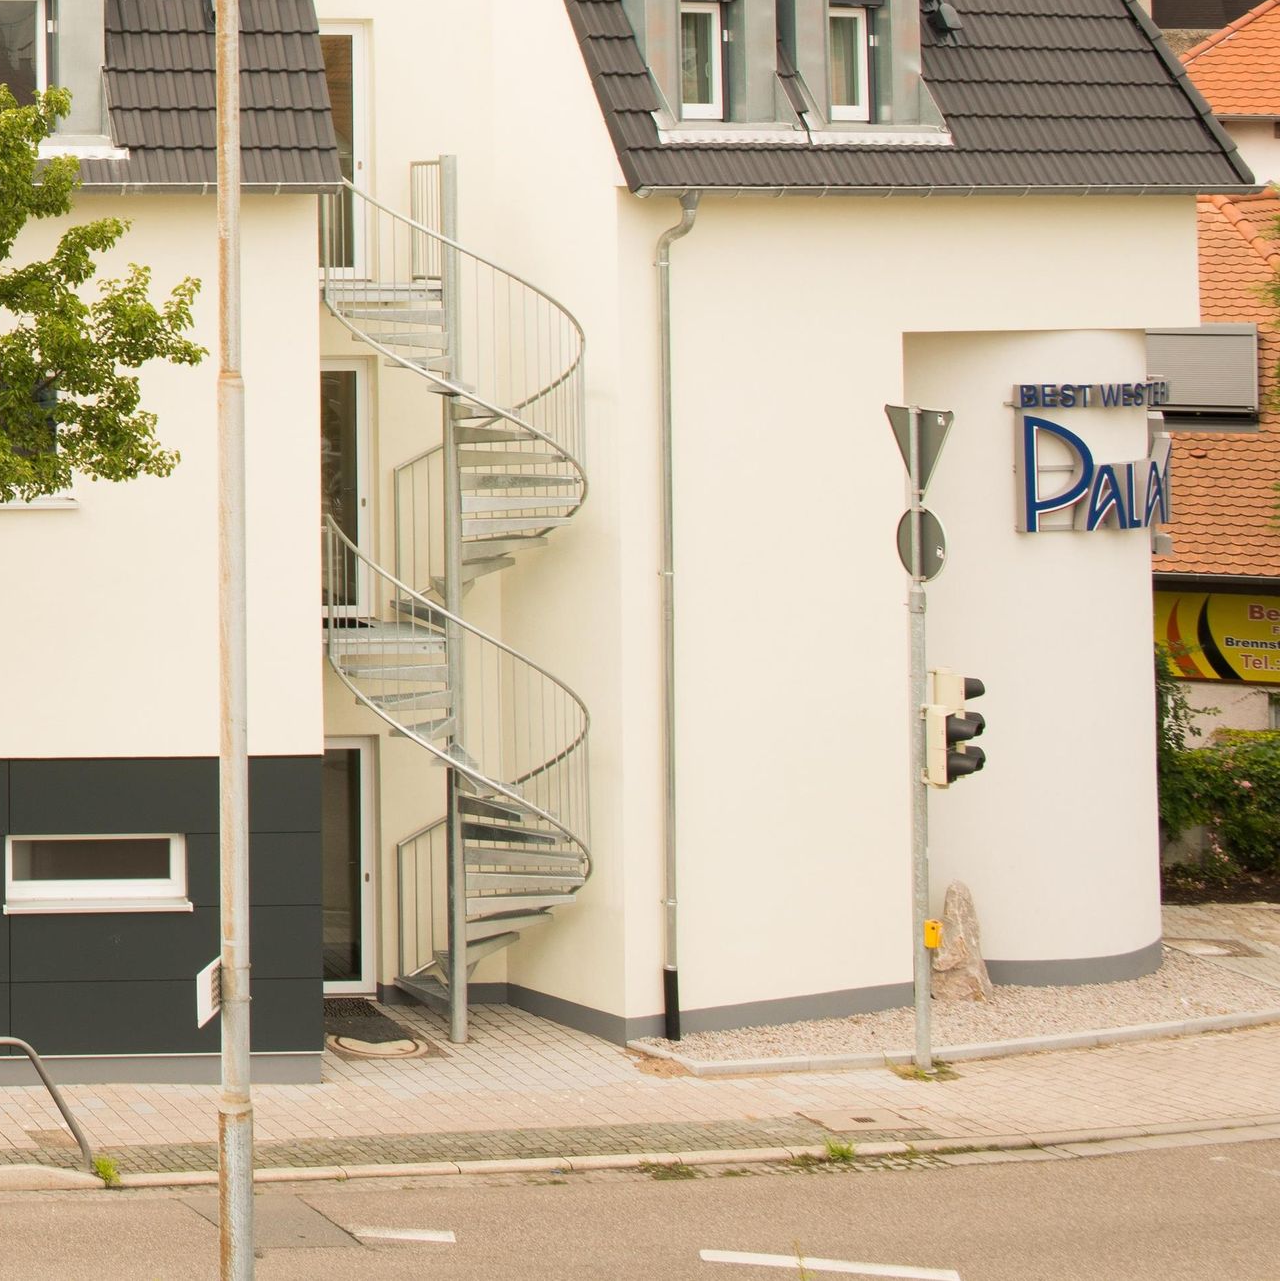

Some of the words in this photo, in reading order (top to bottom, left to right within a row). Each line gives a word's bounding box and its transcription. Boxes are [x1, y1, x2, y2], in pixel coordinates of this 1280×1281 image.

[1020, 384, 1092, 408] BEST
[1100, 382, 1168, 407] WESTER
[1023, 415, 1171, 532] PALA
